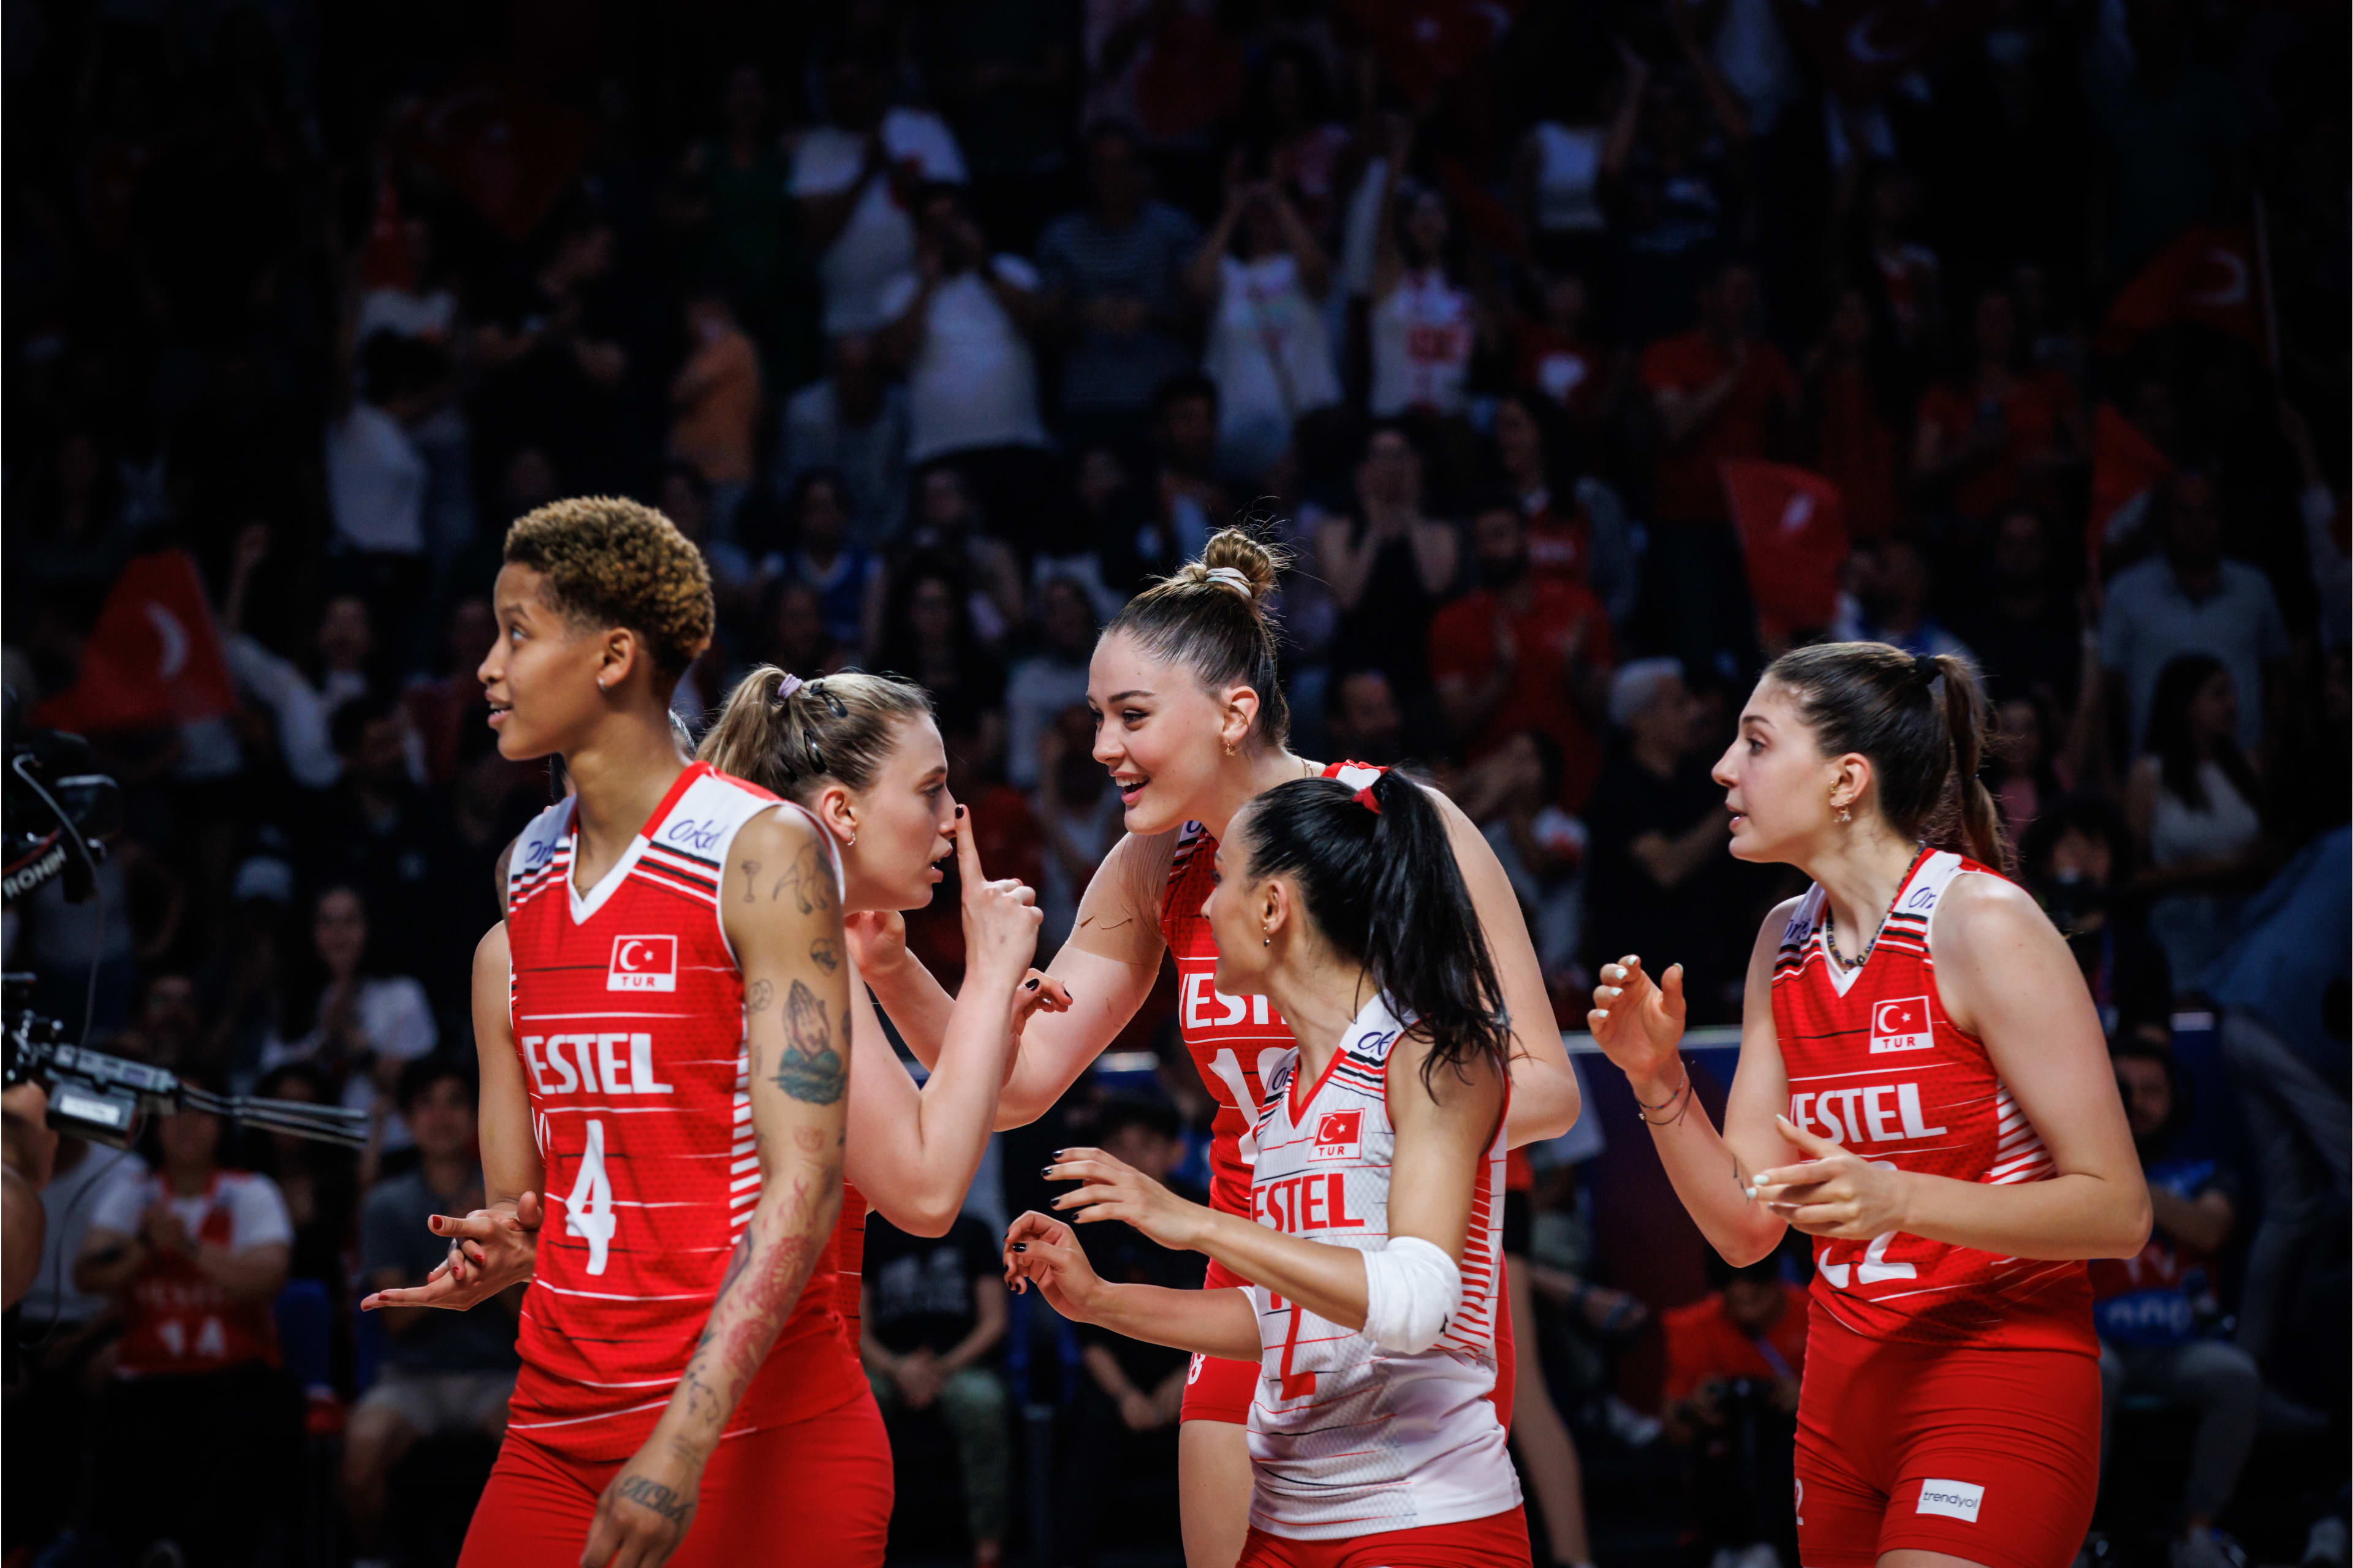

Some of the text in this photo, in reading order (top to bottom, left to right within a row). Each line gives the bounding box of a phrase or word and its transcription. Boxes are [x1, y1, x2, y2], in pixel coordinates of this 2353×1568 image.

[621, 976, 655, 987] TUR
[1882, 1036, 1916, 1049] TUR
[521, 1033, 673, 1095] ESTEL
[1319, 1146, 1345, 1157] TUR
[565, 1119, 616, 1276] 4
[1250, 1173, 1365, 1233] ESTEL
[1923, 1490, 1979, 1509] trendyol
